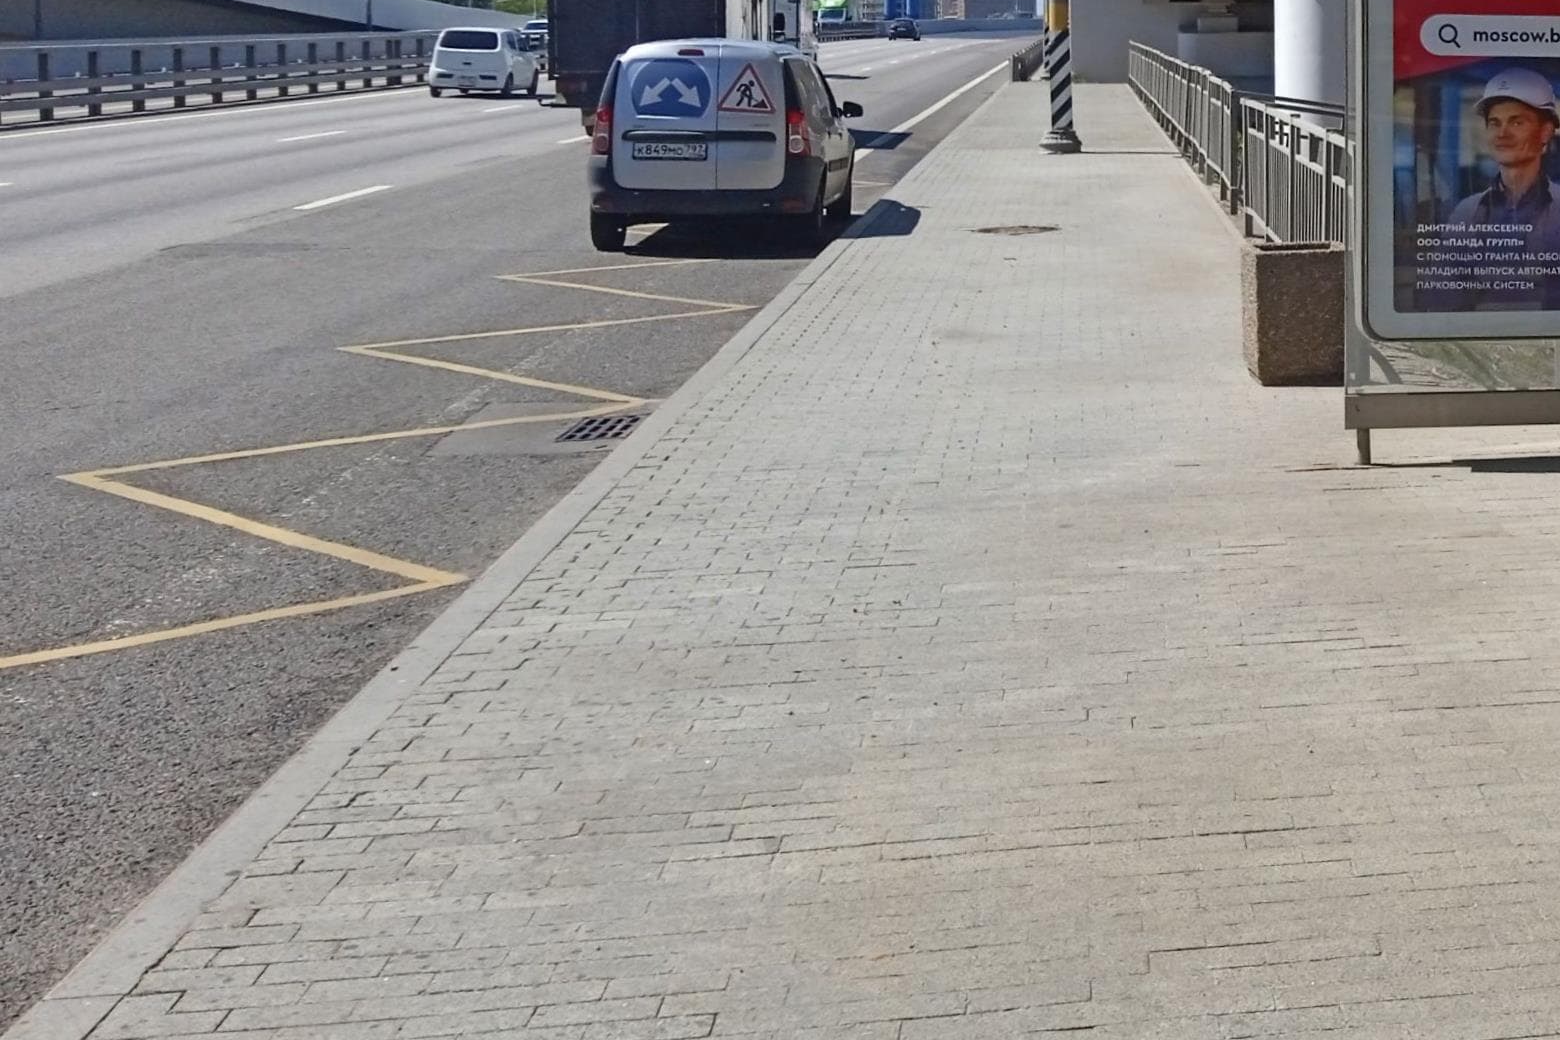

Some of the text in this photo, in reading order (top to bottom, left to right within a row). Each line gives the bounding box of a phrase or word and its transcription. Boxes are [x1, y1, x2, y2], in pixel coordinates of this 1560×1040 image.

[1416, 221, 1533, 233] ДМИТРИЙ АЛЕКСЕЕНКО
[1416, 238, 1441, 246] ООО
[1416, 252, 1425, 260] С
[1426, 252, 1483, 262] ПОМОЩЬЮ
[1485, 252, 1520, 260] ГРАНТА
[1522, 252, 1536, 260] НА
[1416, 267, 1471, 276] НАЛАДИЛИ
[1474, 267, 1515, 275] ВЫПУСК
[1416, 281, 1534, 289] ПАРКОВОЧНЫХ СИСТЕМ
